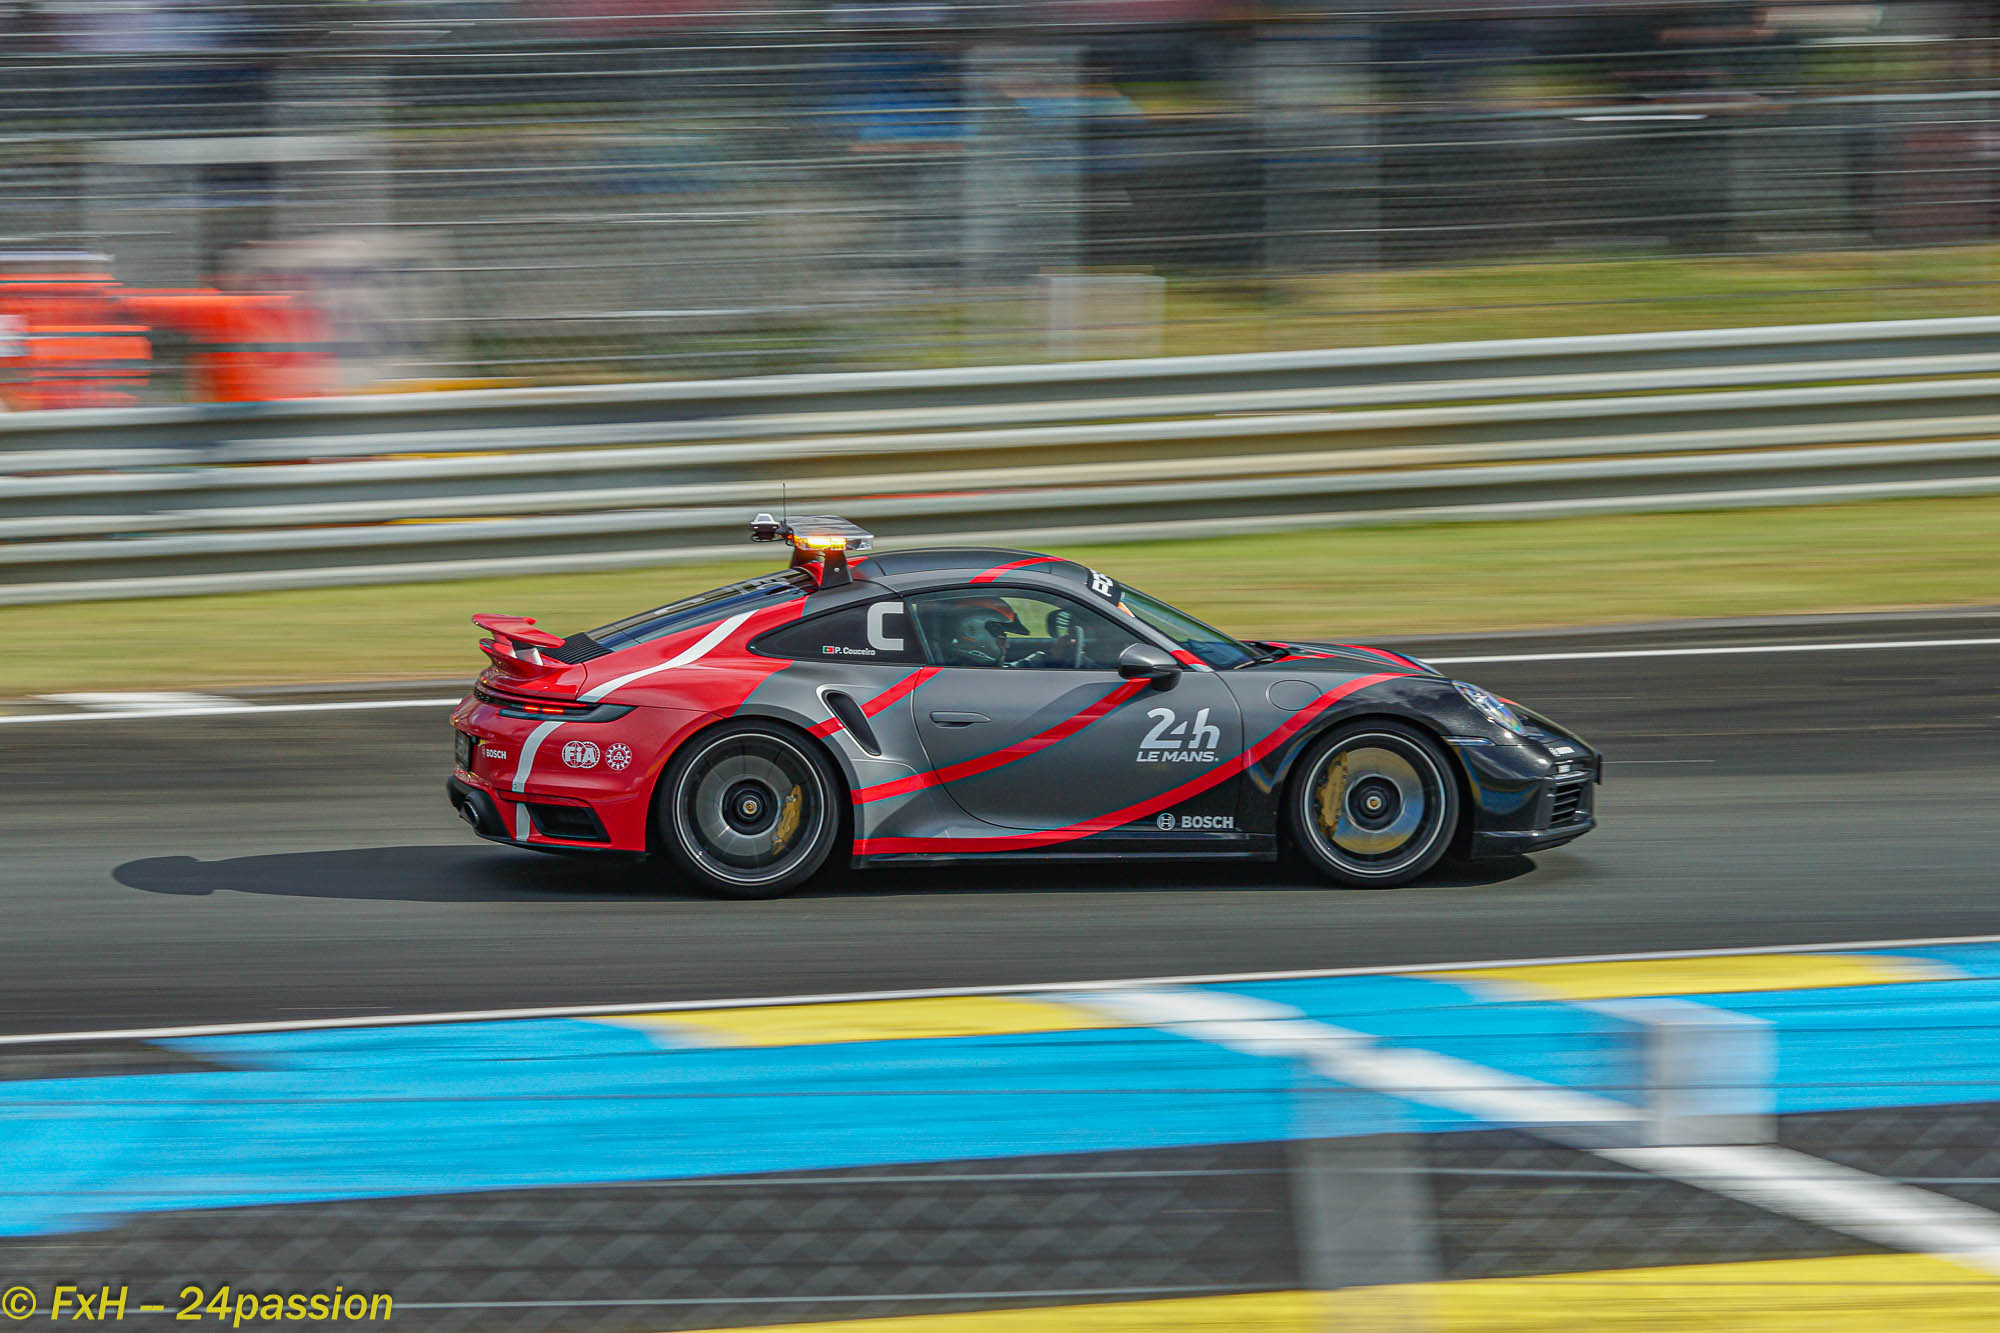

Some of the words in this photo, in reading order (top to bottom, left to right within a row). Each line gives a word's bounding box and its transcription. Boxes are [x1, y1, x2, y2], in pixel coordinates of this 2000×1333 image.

[867, 602, 904, 651] C
[834, 647, 842, 655] P.
[843, 647, 876, 656] Couceiro
[1139, 707, 1220, 749] 24h
[486, 748, 507, 760] BOSCH
[1136, 751, 1160, 762] LE
[1181, 816, 1234, 829] BOSCH
